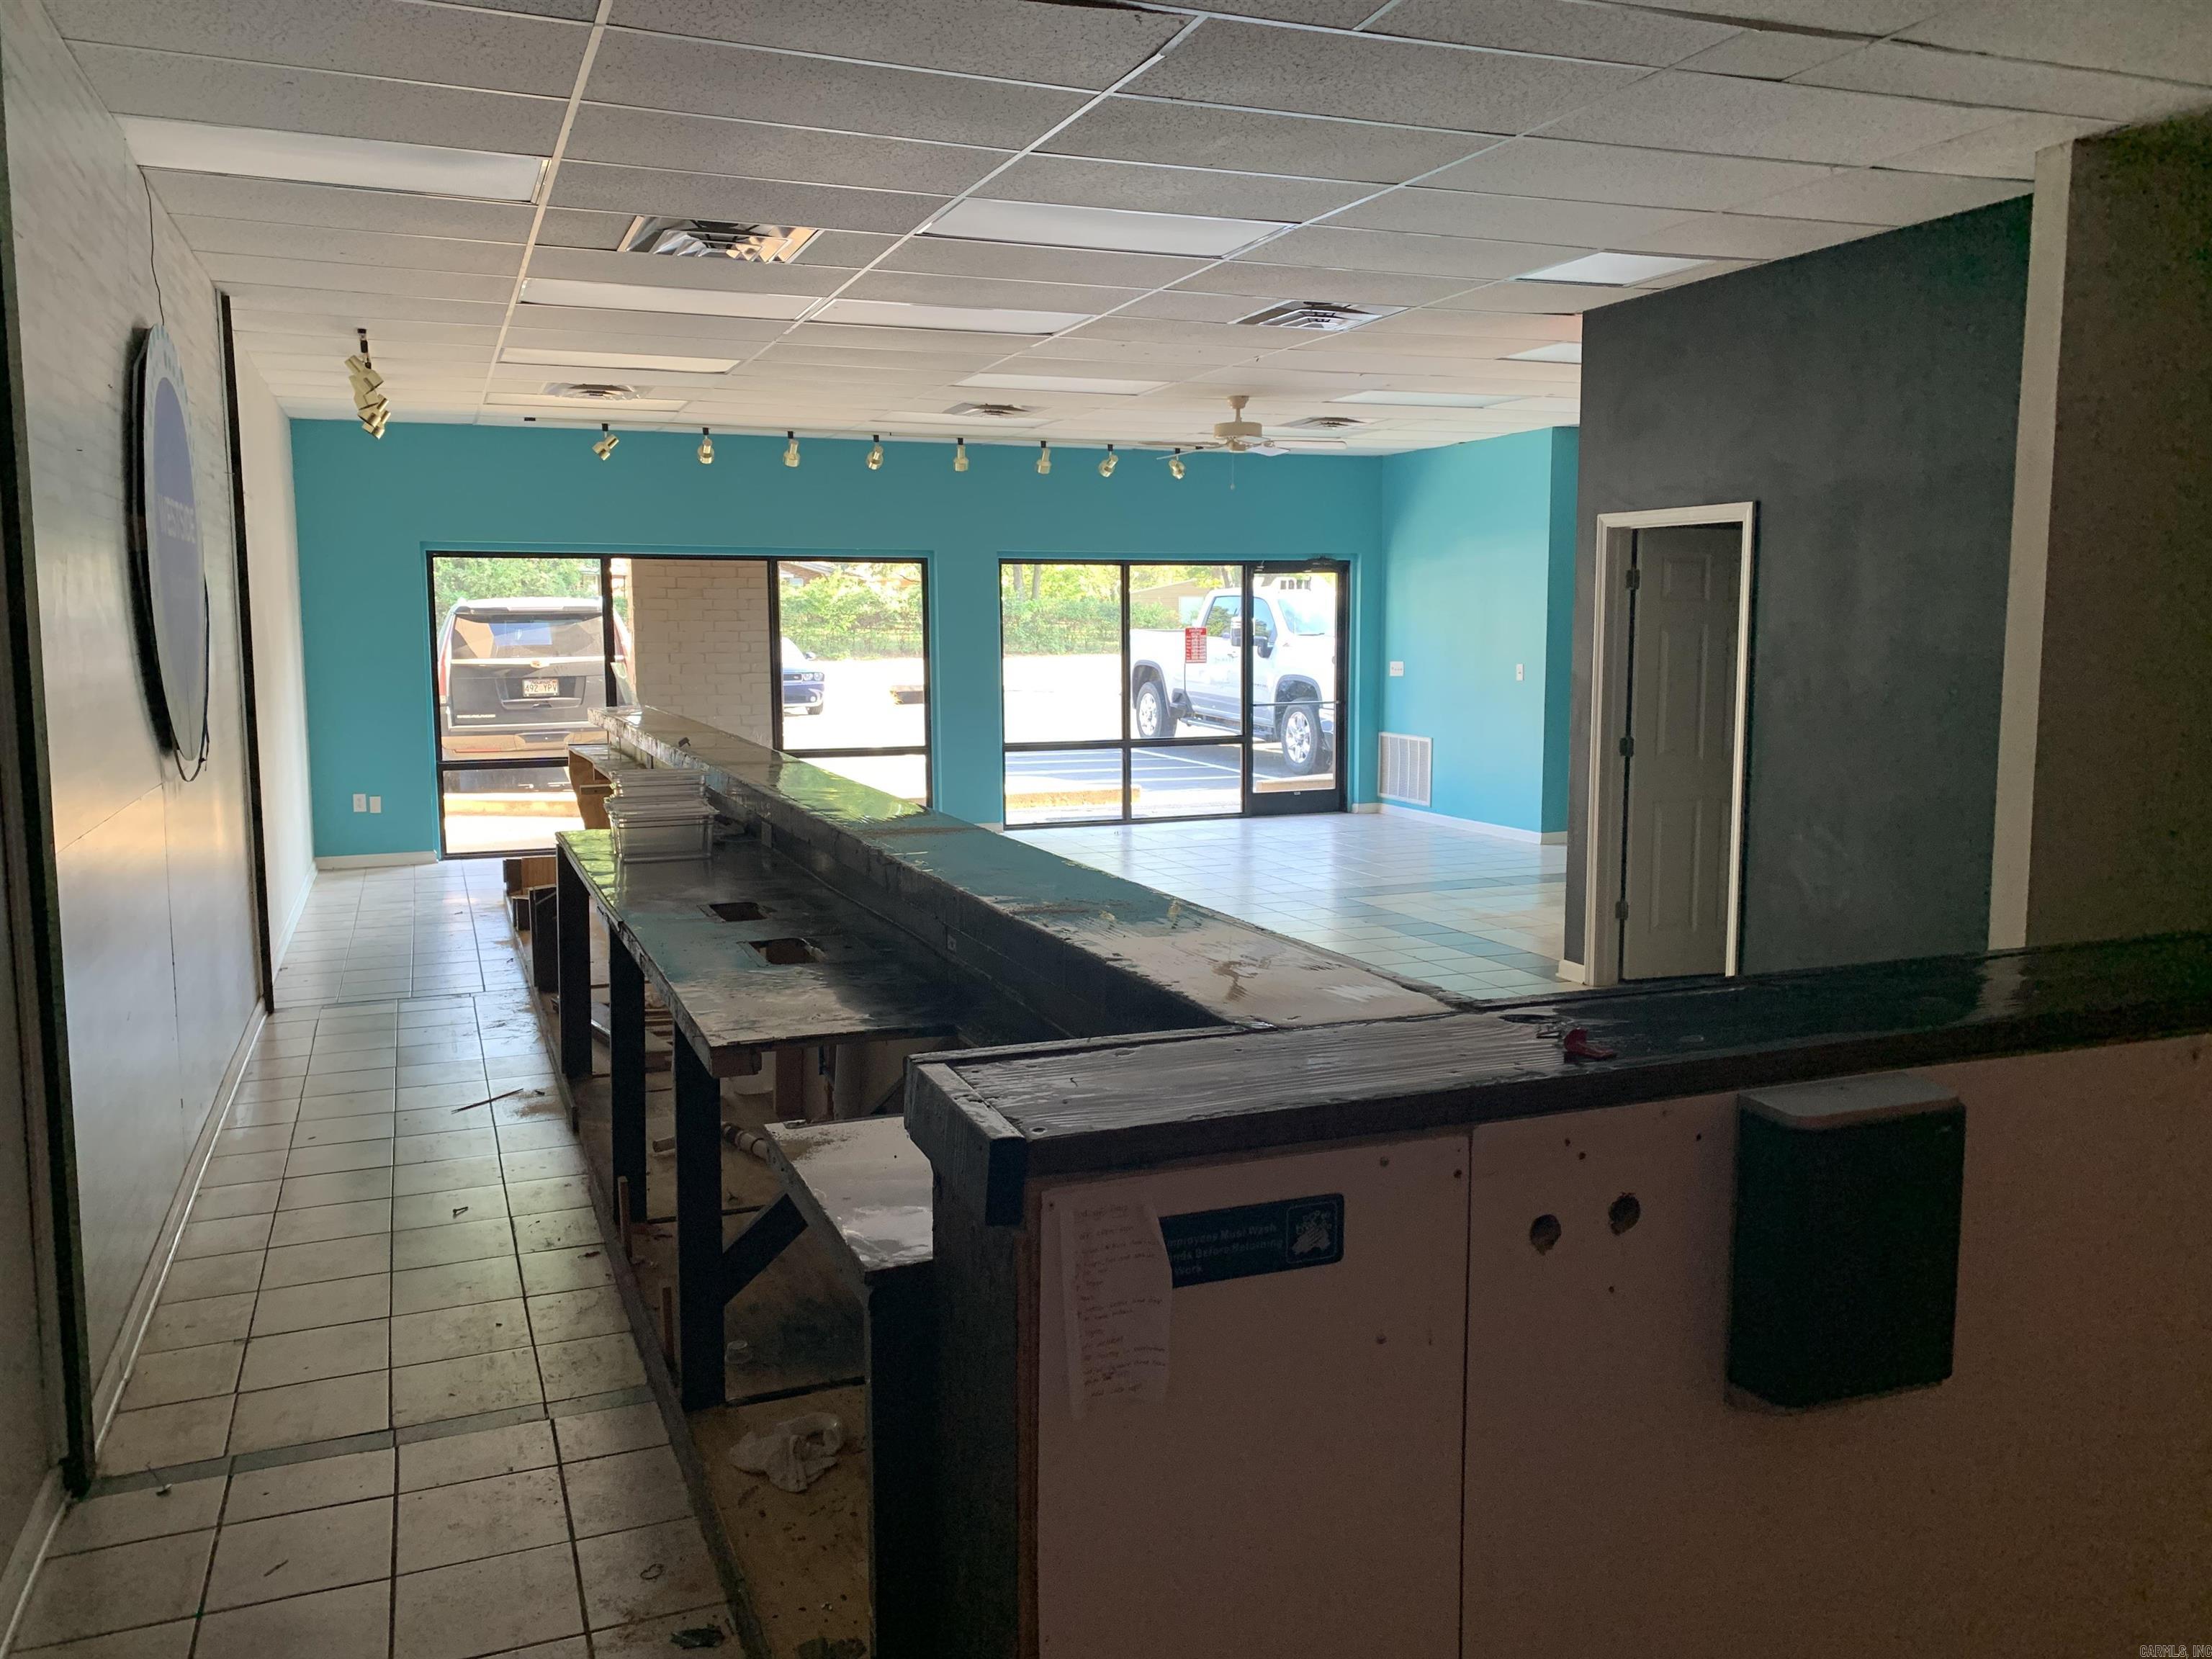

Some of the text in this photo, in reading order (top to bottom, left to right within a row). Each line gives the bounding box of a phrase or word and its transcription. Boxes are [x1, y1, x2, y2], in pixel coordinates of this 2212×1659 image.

[1167, 1233, 1218, 1248] mployees
[1220, 1229, 1246, 1240] Must
[1249, 1223, 1277, 1236] Wash
[1169, 1250, 1192, 1262] nds
[1195, 1246, 1231, 1259] Before
[1232, 1239, 1284, 1252] Returning
[1174, 1264, 1203, 1276] Work
